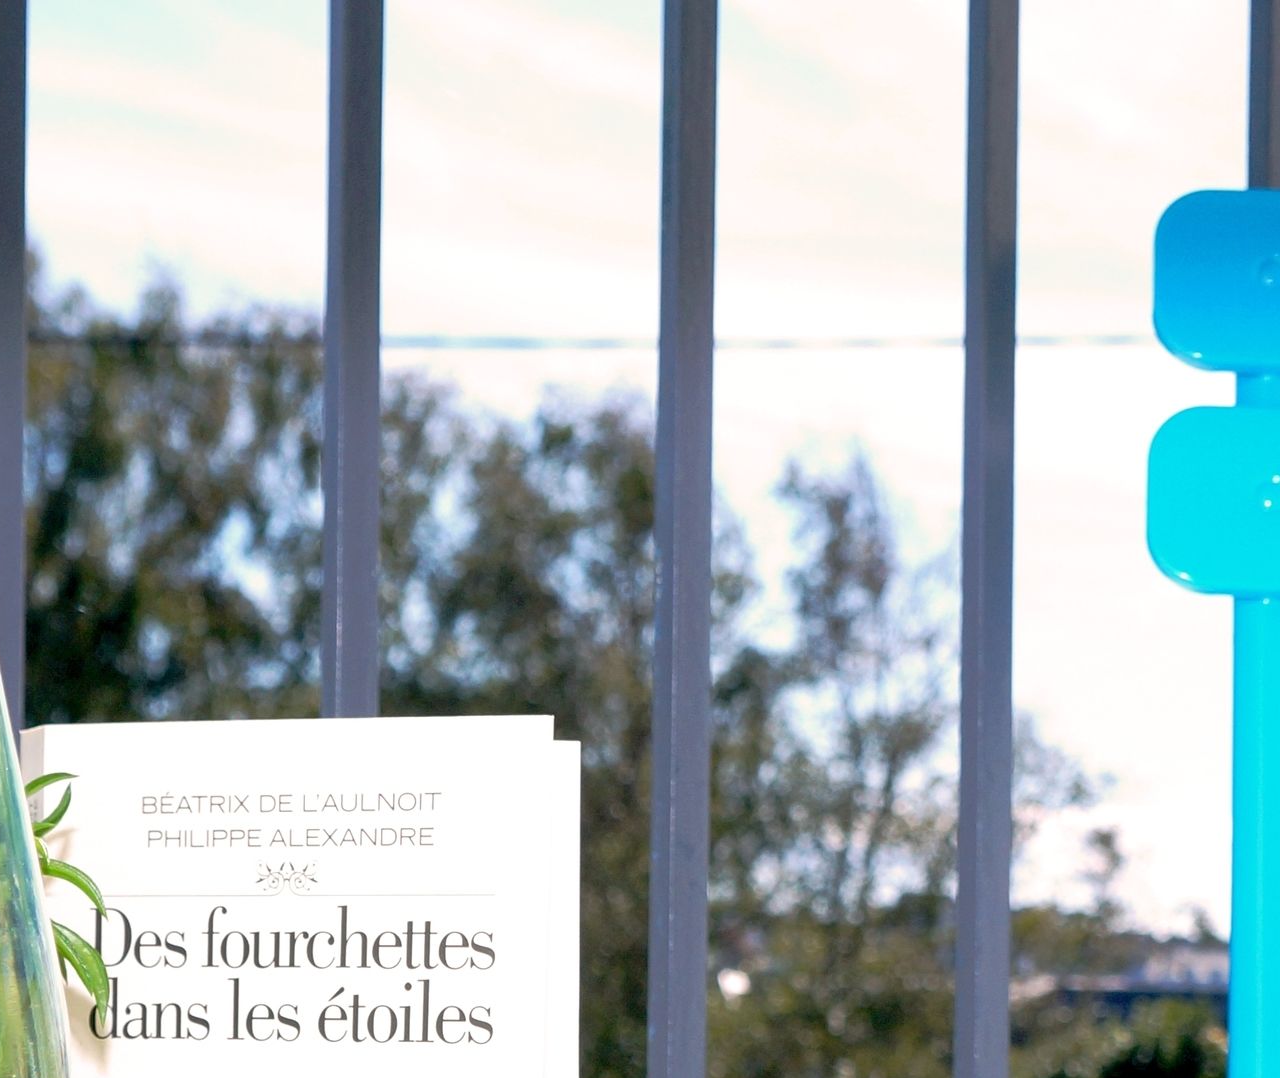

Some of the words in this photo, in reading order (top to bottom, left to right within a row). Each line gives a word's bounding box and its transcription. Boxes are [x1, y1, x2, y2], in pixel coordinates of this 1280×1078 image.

[141, 791, 250, 814] BÉATRIX
[259, 795, 294, 813] DE
[302, 792, 442, 812] L'AULNOIT
[147, 829, 262, 848] PHILIPPE
[269, 827, 435, 848] ALEXANDRE
[90, 907, 187, 968] Des
[201, 905, 496, 970] fourchettes
[89, 976, 211, 1041] dans
[227, 977, 301, 1042] les
[318, 979, 494, 1045] étoiles
